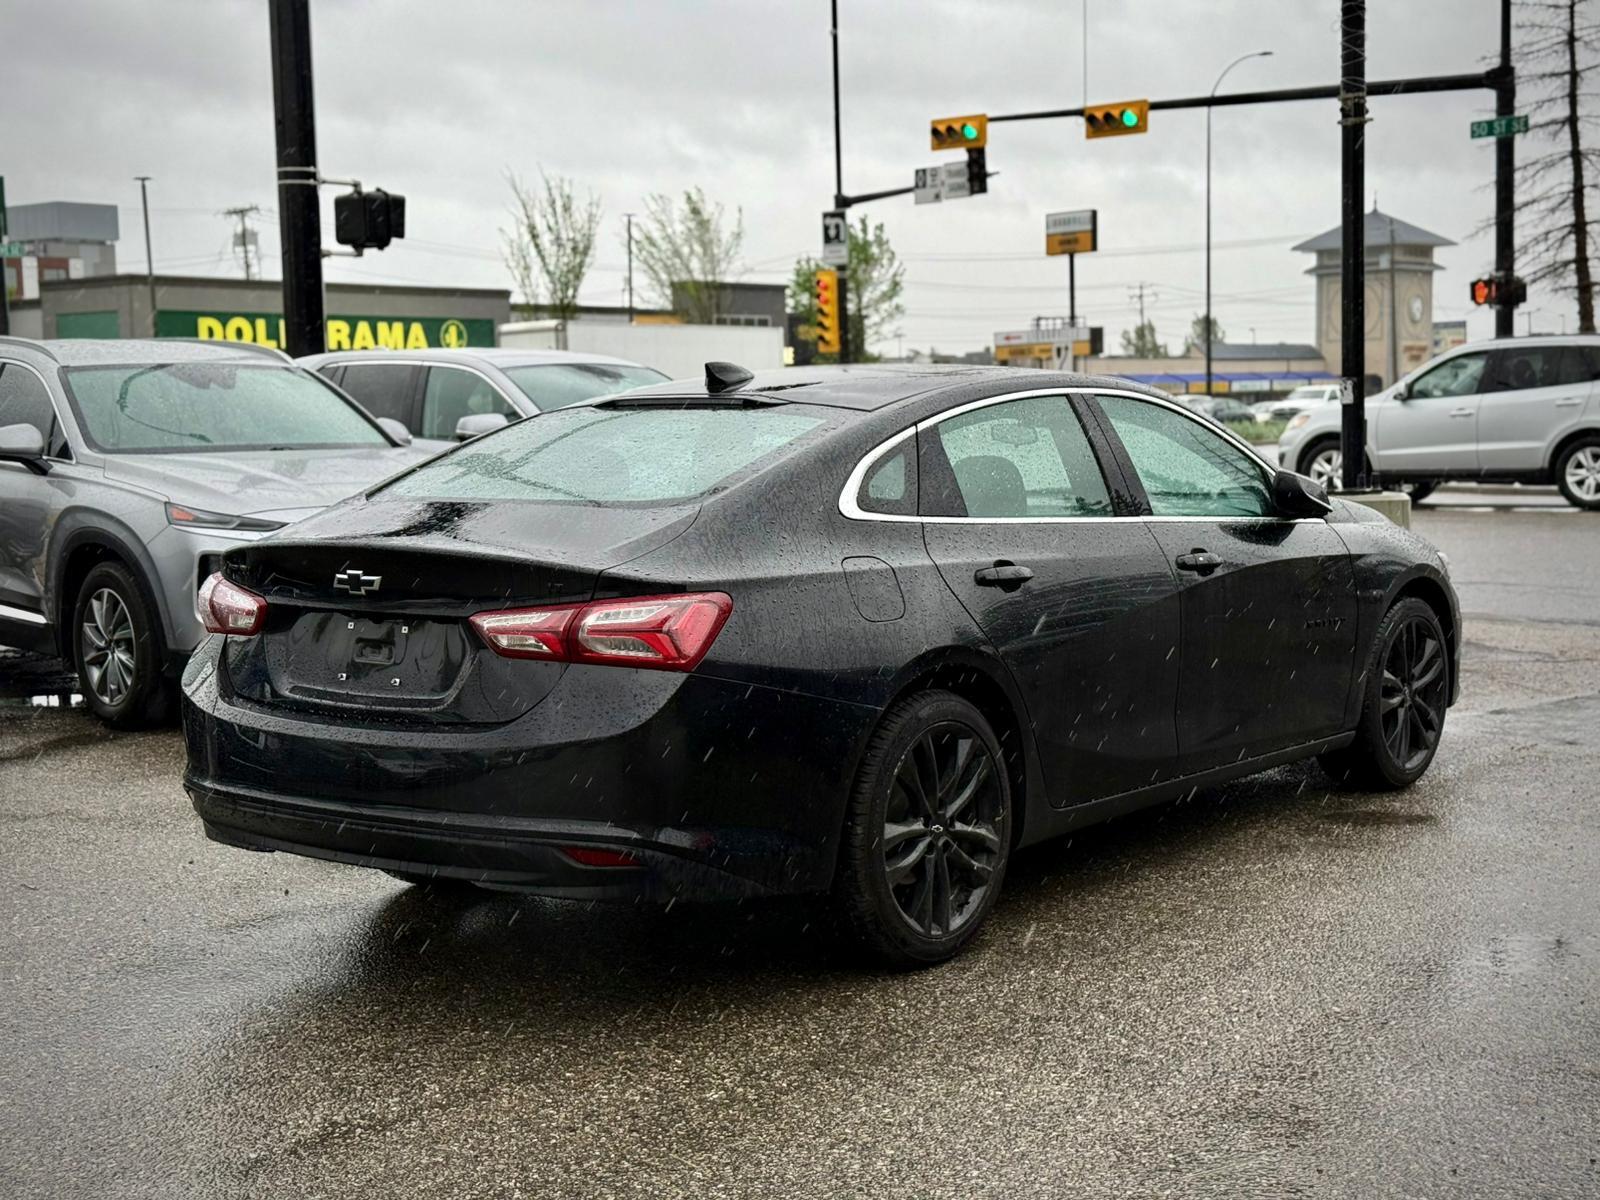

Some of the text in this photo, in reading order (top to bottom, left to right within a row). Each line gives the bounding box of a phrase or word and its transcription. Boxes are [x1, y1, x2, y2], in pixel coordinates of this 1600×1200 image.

[1472, 116, 1528, 137] 50 ST SE
[197, 316, 429, 350] DOLRAMA
